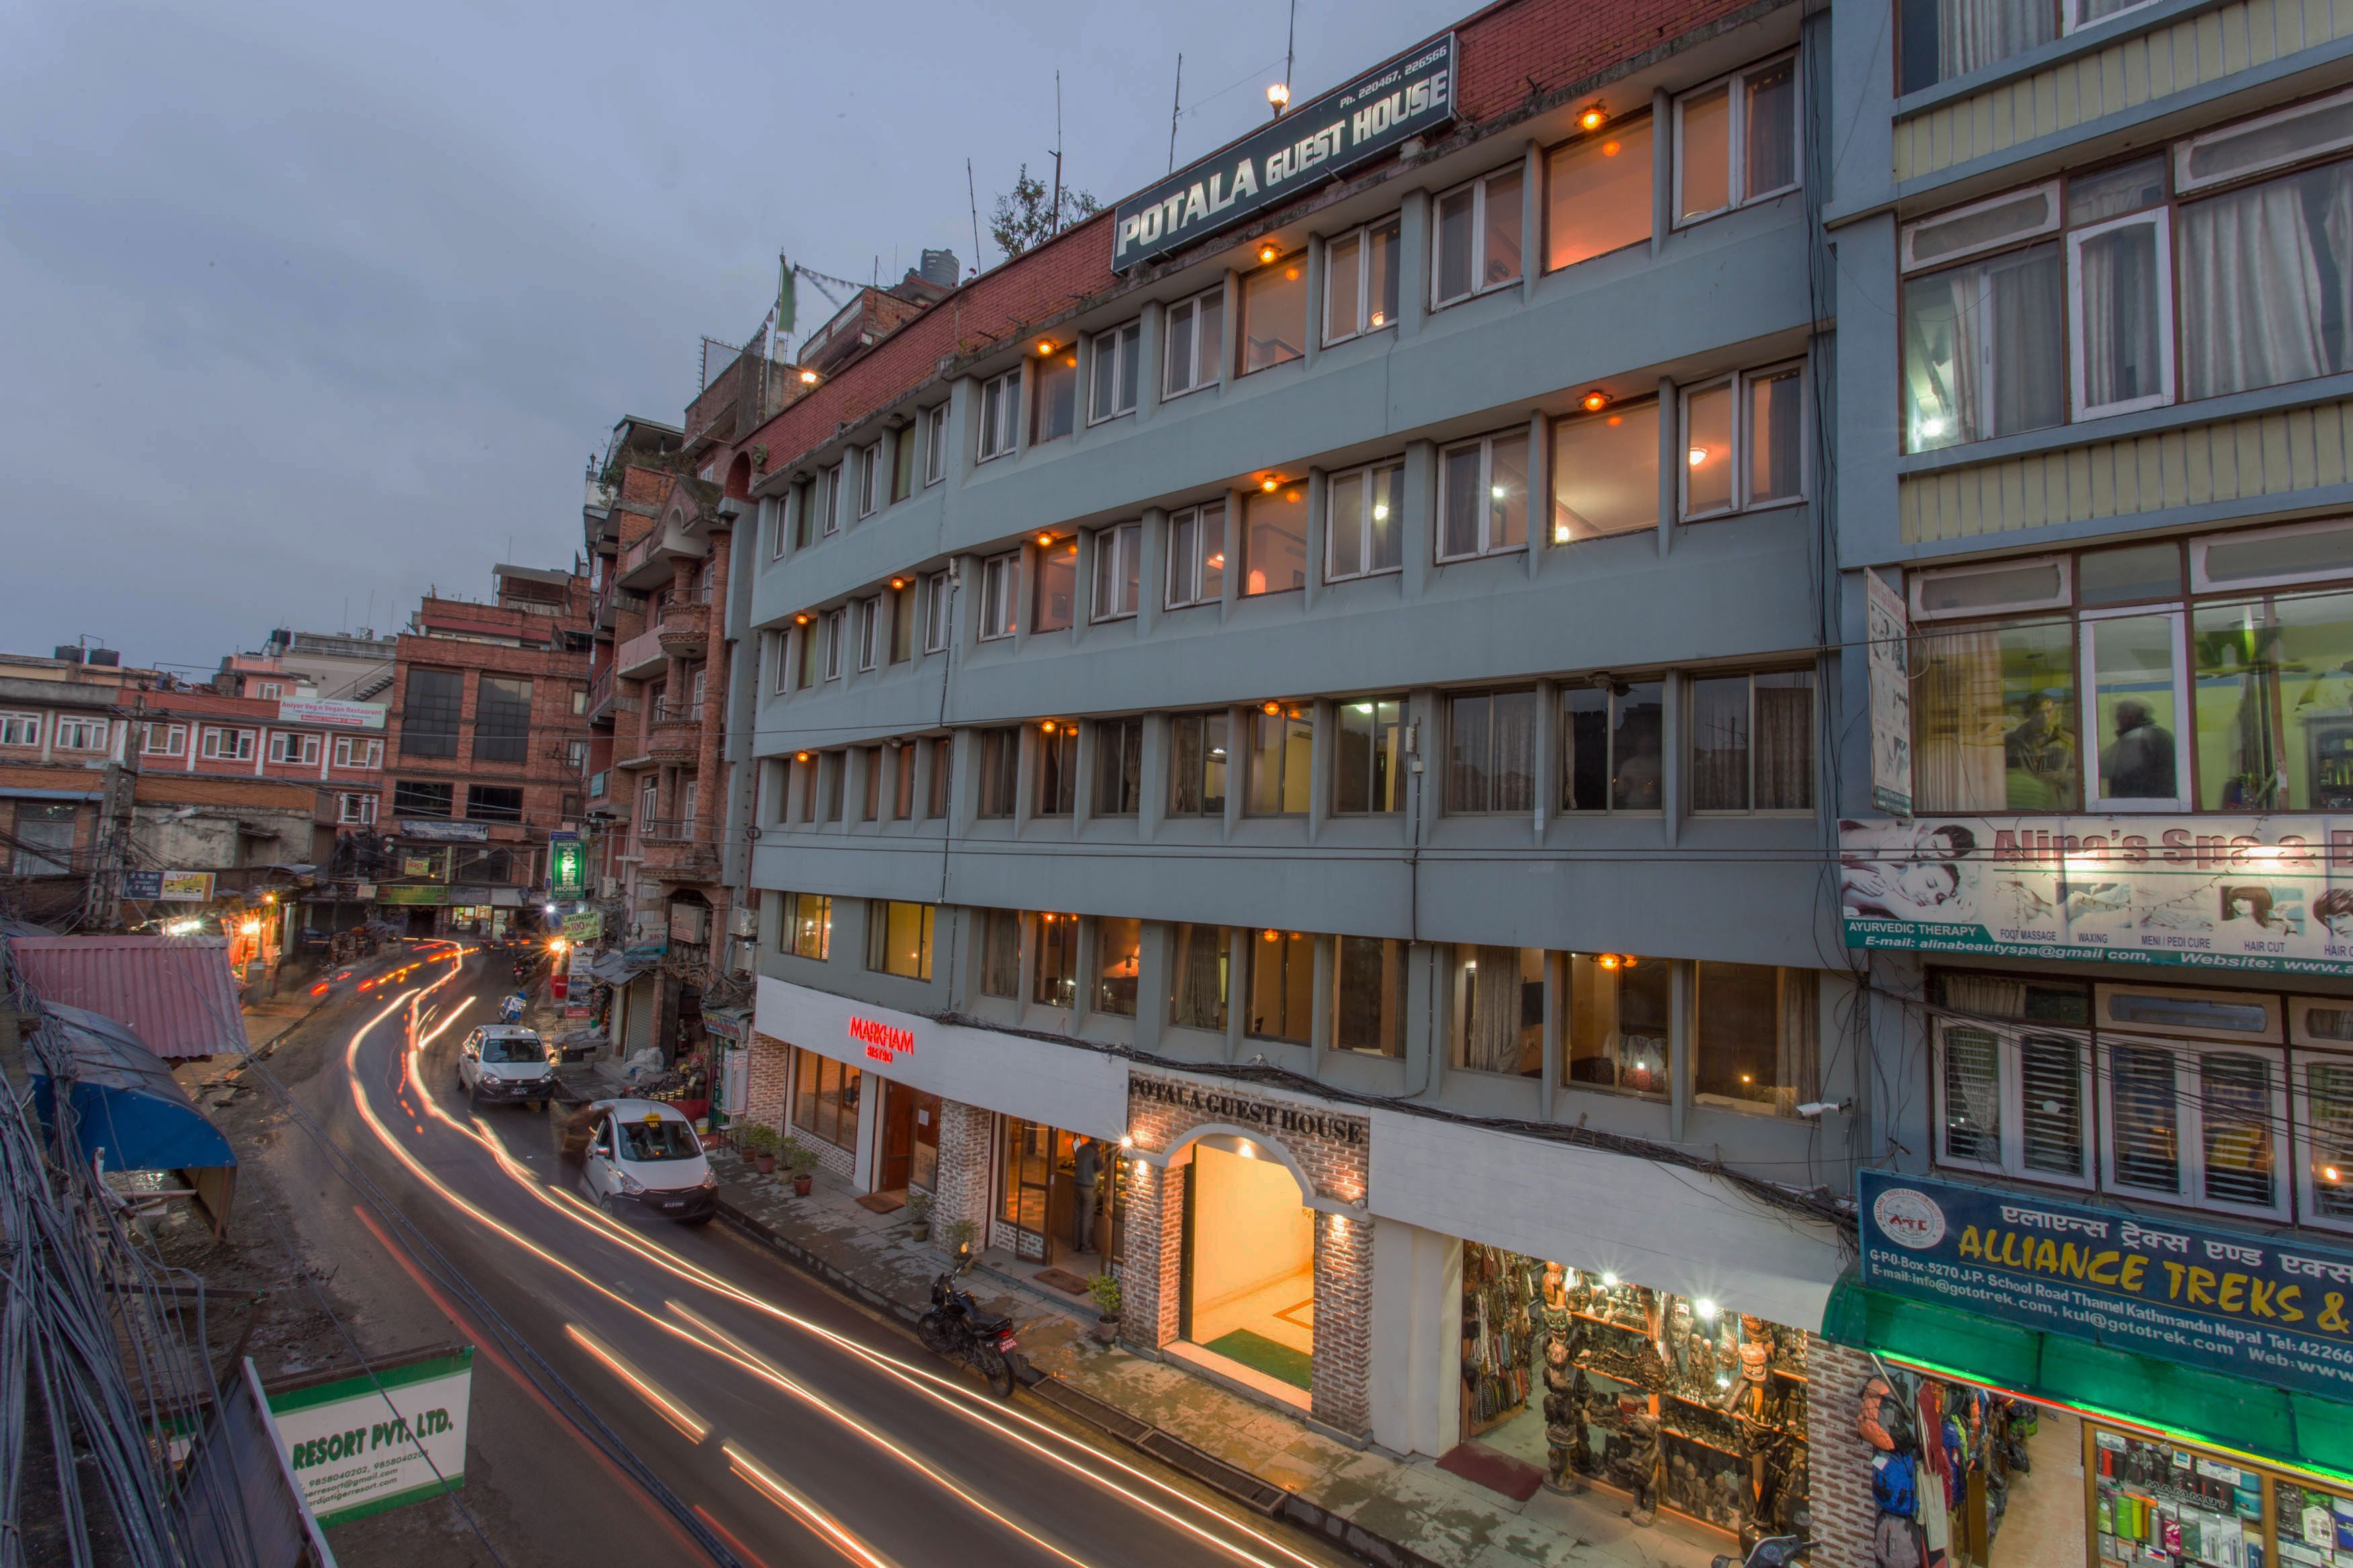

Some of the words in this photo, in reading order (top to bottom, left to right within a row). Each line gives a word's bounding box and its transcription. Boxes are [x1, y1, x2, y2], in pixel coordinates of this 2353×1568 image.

[1340, 97, 1355, 109] Ph.
[1358, 69, 1402, 99] 220467,
[1404, 44, 1447, 75] 226566
[1117, 158, 1259, 257] POTALA
[1266, 120, 1346, 188] GUEST
[1353, 69, 1448, 146] HOUSE
[305, 703, 317, 711] Veg
[324, 704, 345, 712] Vegan
[346, 706, 383, 715] Restaurant
[1993, 829, 2149, 865] Alina's
[2161, 828, 2261, 870] Spa
[2277, 835, 2317, 867] &
[571, 921, 585, 931] 100
[1849, 921, 1915, 934] AYURVEDIC
[1917, 924, 1977, 937] THERAPY
[2000, 929, 2019, 940] FOOT
[2020, 930, 2057, 941] MASSAGE
[2078, 932, 2108, 944] WAXING
[2141, 935, 2161, 946] MENI
[2167, 937, 2186, 948] PEDI
[2188, 938, 2210, 948] CURE
[1865, 936, 1915, 948] E-mail:
[2180, 952, 2276, 969] Website:
[2244, 941, 2265, 952] HAIR
[2267, 942, 2285, 953] CUT
[2324, 944, 2346, 956] HAIR
[850, 1016, 914, 1056] MARKHAM
[865, 1044, 893, 1064] BISTRO
[1129, 1078, 1201, 1110] POTALA
[1205, 1093, 1277, 1126] GUEST
[1281, 1109, 1363, 1144] HOUSE
[1999, 1205, 2109, 1238] एलाएन्स
[2203, 1239, 2263, 1266] एण्ड
[1958, 1225, 2150, 1292] ALLIANCE
[2163, 1260, 2306, 1323] TREKS
[2317, 1291, 2351, 1335] &
[1988, 1274, 2032, 1294] School
[2035, 1284, 2069, 1303] Road
[2072, 1291, 2124, 1314] Thamel
[2126, 1303, 2213, 1335] Kathmandu
[2215, 1323, 2262, 1346] Nepal
[2063, 1305, 2235, 1356] kul@gototrek.com
[292, 1428, 367, 1471] RESORT
[371, 1417, 411, 1451] PVT.
[417, 1407, 454, 1439] LTD.
[309, 1465, 370, 1488] 9858040202,
[2146, 1479, 2228, 1510] MAMMUT
